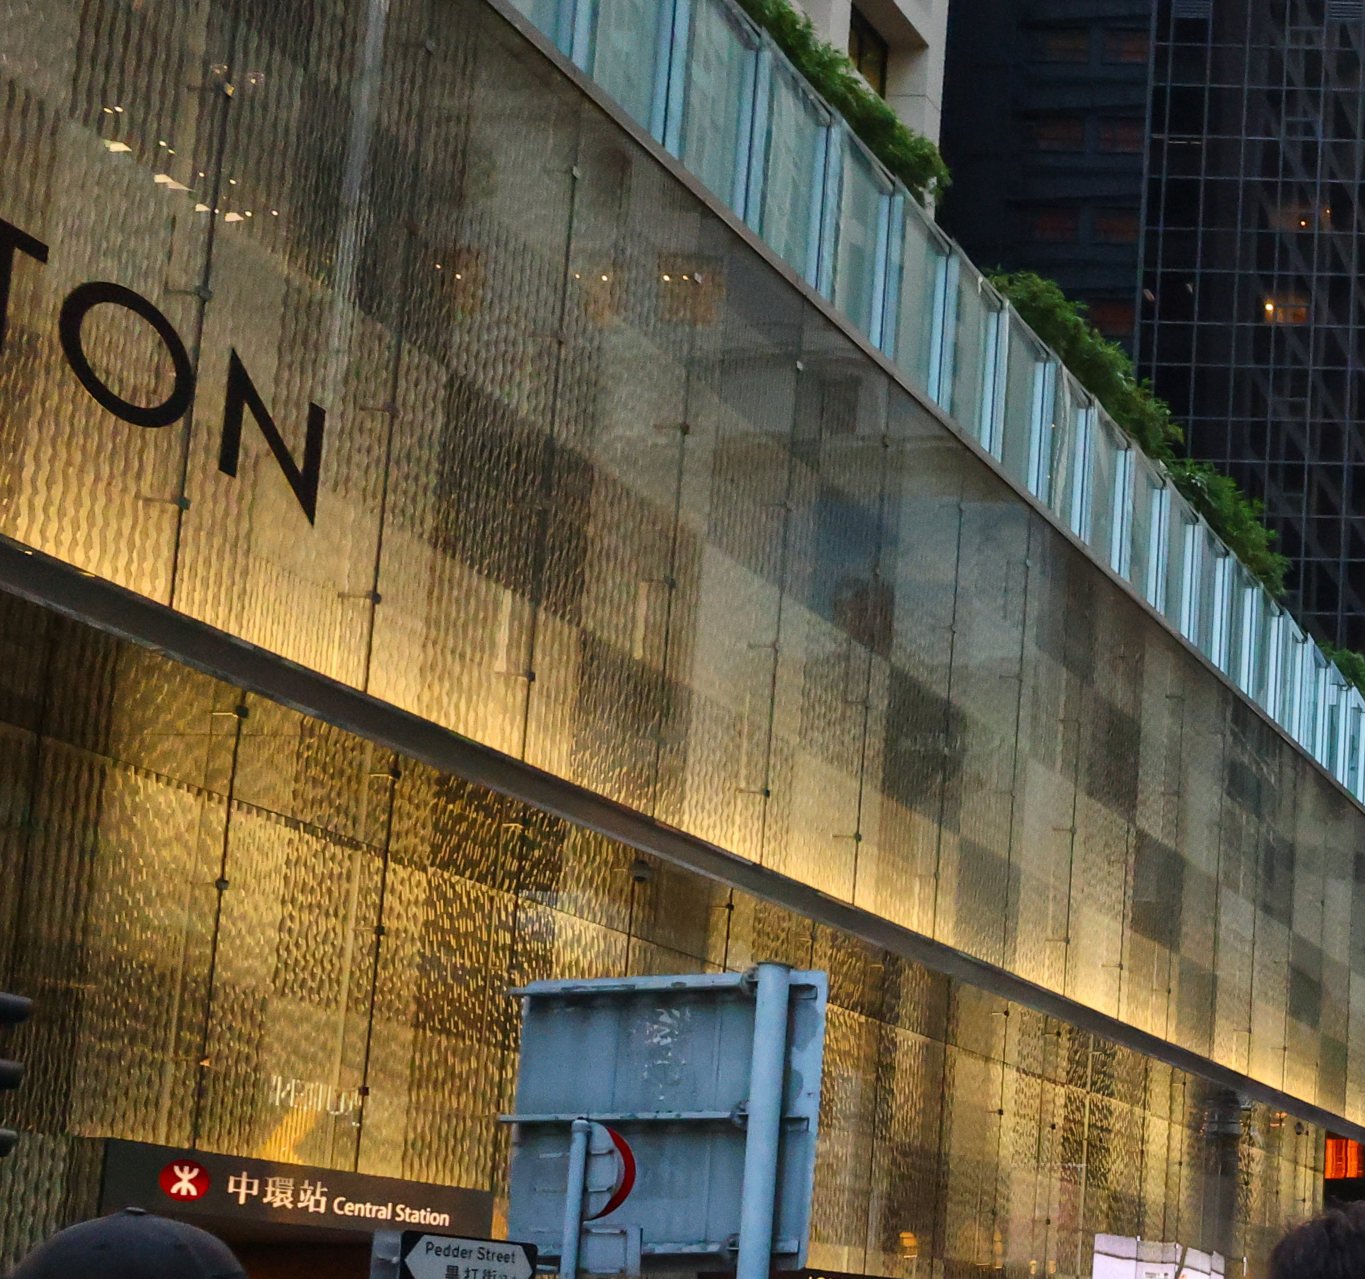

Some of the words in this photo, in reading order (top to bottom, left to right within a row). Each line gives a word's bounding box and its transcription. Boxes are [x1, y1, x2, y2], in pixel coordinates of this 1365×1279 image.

[227, 1171, 329, 1215] 中環站
[333, 1196, 391, 1221] Central
[395, 1204, 450, 1227] Station
[425, 1242, 472, 1260] Pedder
[477, 1246, 516, 1264] Street
